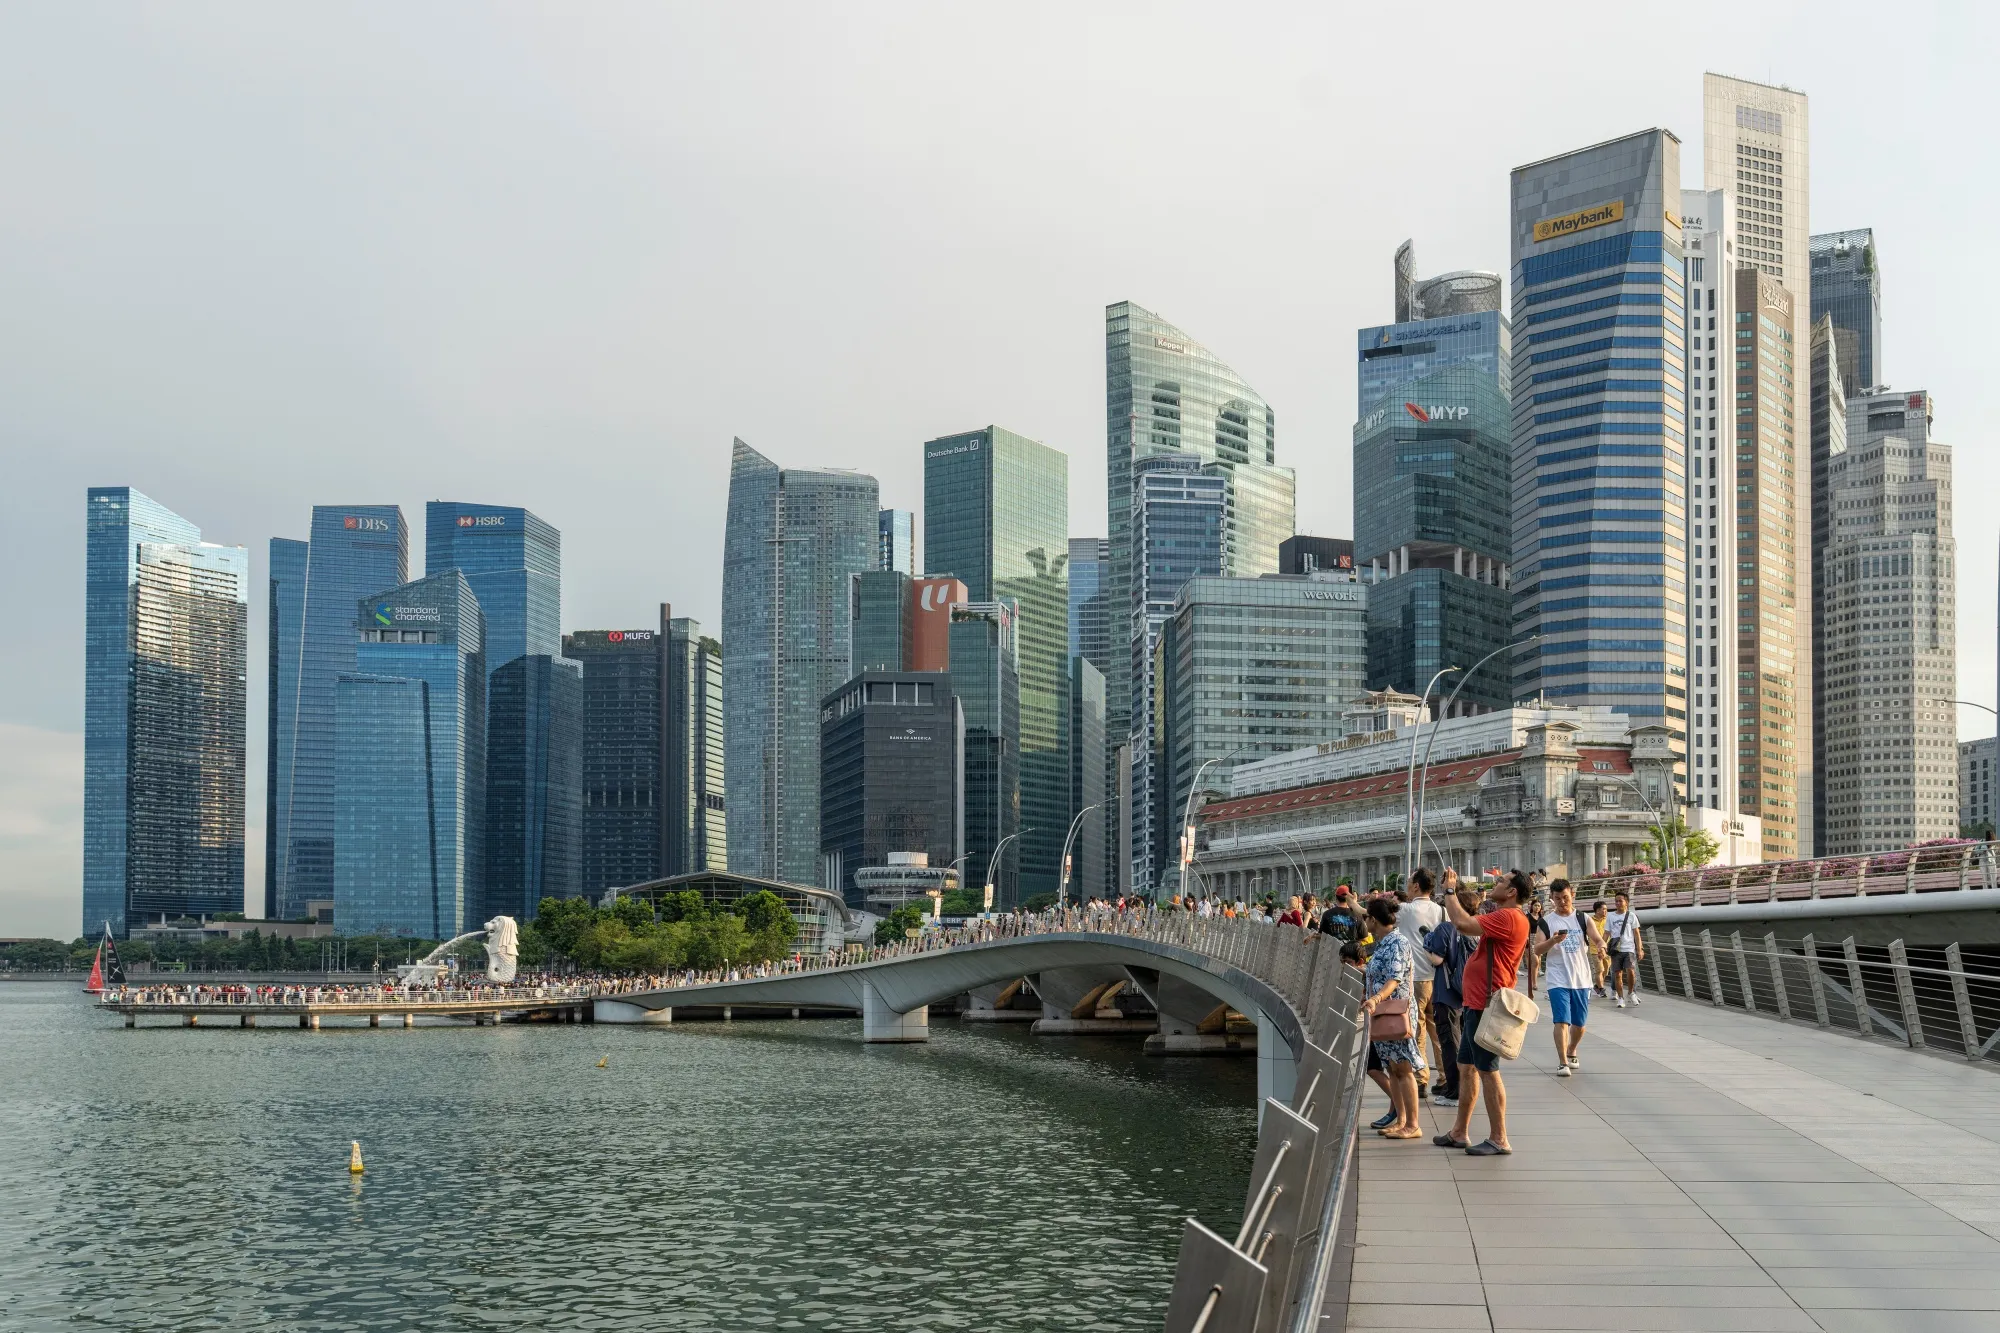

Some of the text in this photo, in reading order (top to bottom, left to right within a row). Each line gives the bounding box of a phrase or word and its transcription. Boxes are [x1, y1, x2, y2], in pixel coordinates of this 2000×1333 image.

[1552, 207, 1615, 233] Maybank
[1395, 321, 1482, 341] SINGAPORELAND
[1158, 338, 1183, 351] Keppel
[1430, 406, 1469, 420] MYP
[1905, 410, 1926, 419] UOB
[1365, 410, 1385, 431] MYP
[928, 446, 969, 458] Deutsche Bank
[358, 518, 389, 531] DBS
[476, 516, 505, 526] HSBC
[1303, 589, 1357, 601] wework
[395, 606, 438, 614] standard
[395, 613, 441, 622] chartered
[624, 632, 651, 640] MUFG
[1317, 729, 1397, 754] THE FULLERTON HOTEL
